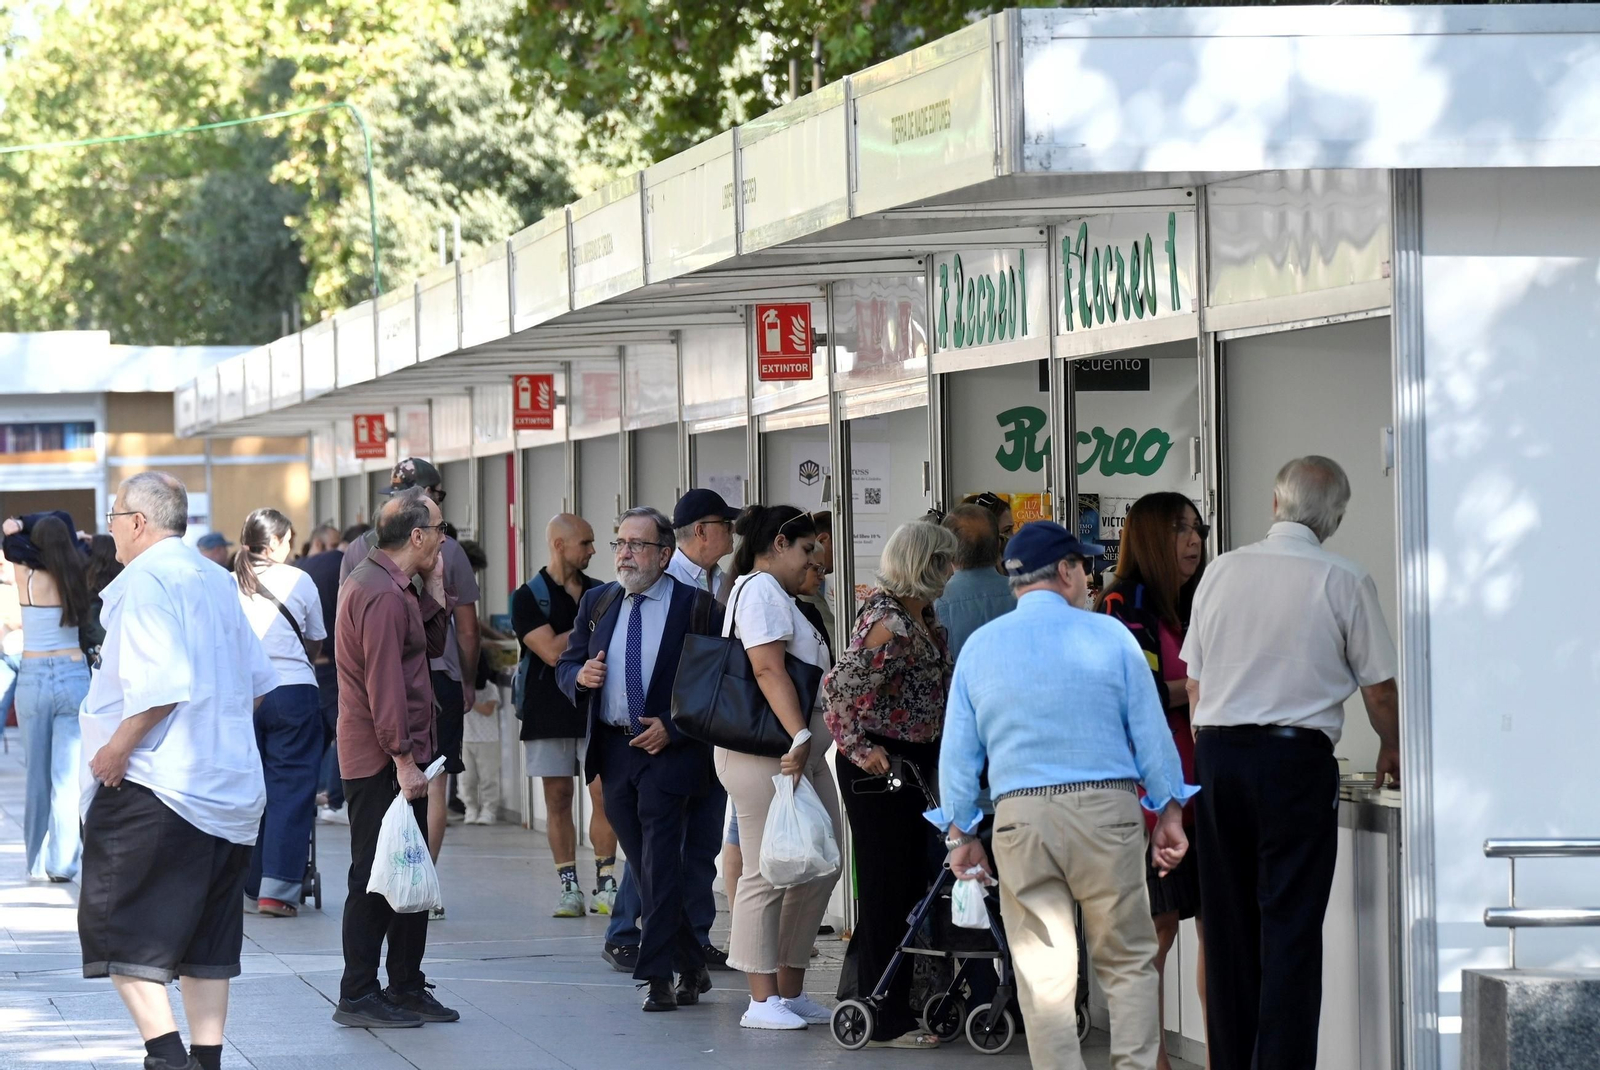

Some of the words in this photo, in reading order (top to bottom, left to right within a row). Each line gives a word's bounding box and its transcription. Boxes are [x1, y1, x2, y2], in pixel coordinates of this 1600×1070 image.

[1075, 221, 1157, 329] Recreo
[953, 253, 1017, 349] Recreo
[761, 363, 809, 374] EXTINTOR
[1074, 358, 1142, 372] scuento
[515, 416, 551, 426] EXTINTOR
[995, 406, 1174, 477] Rcreo
[1024, 500, 1038, 510] LUZ
[1102, 516, 1126, 528] VICTO
